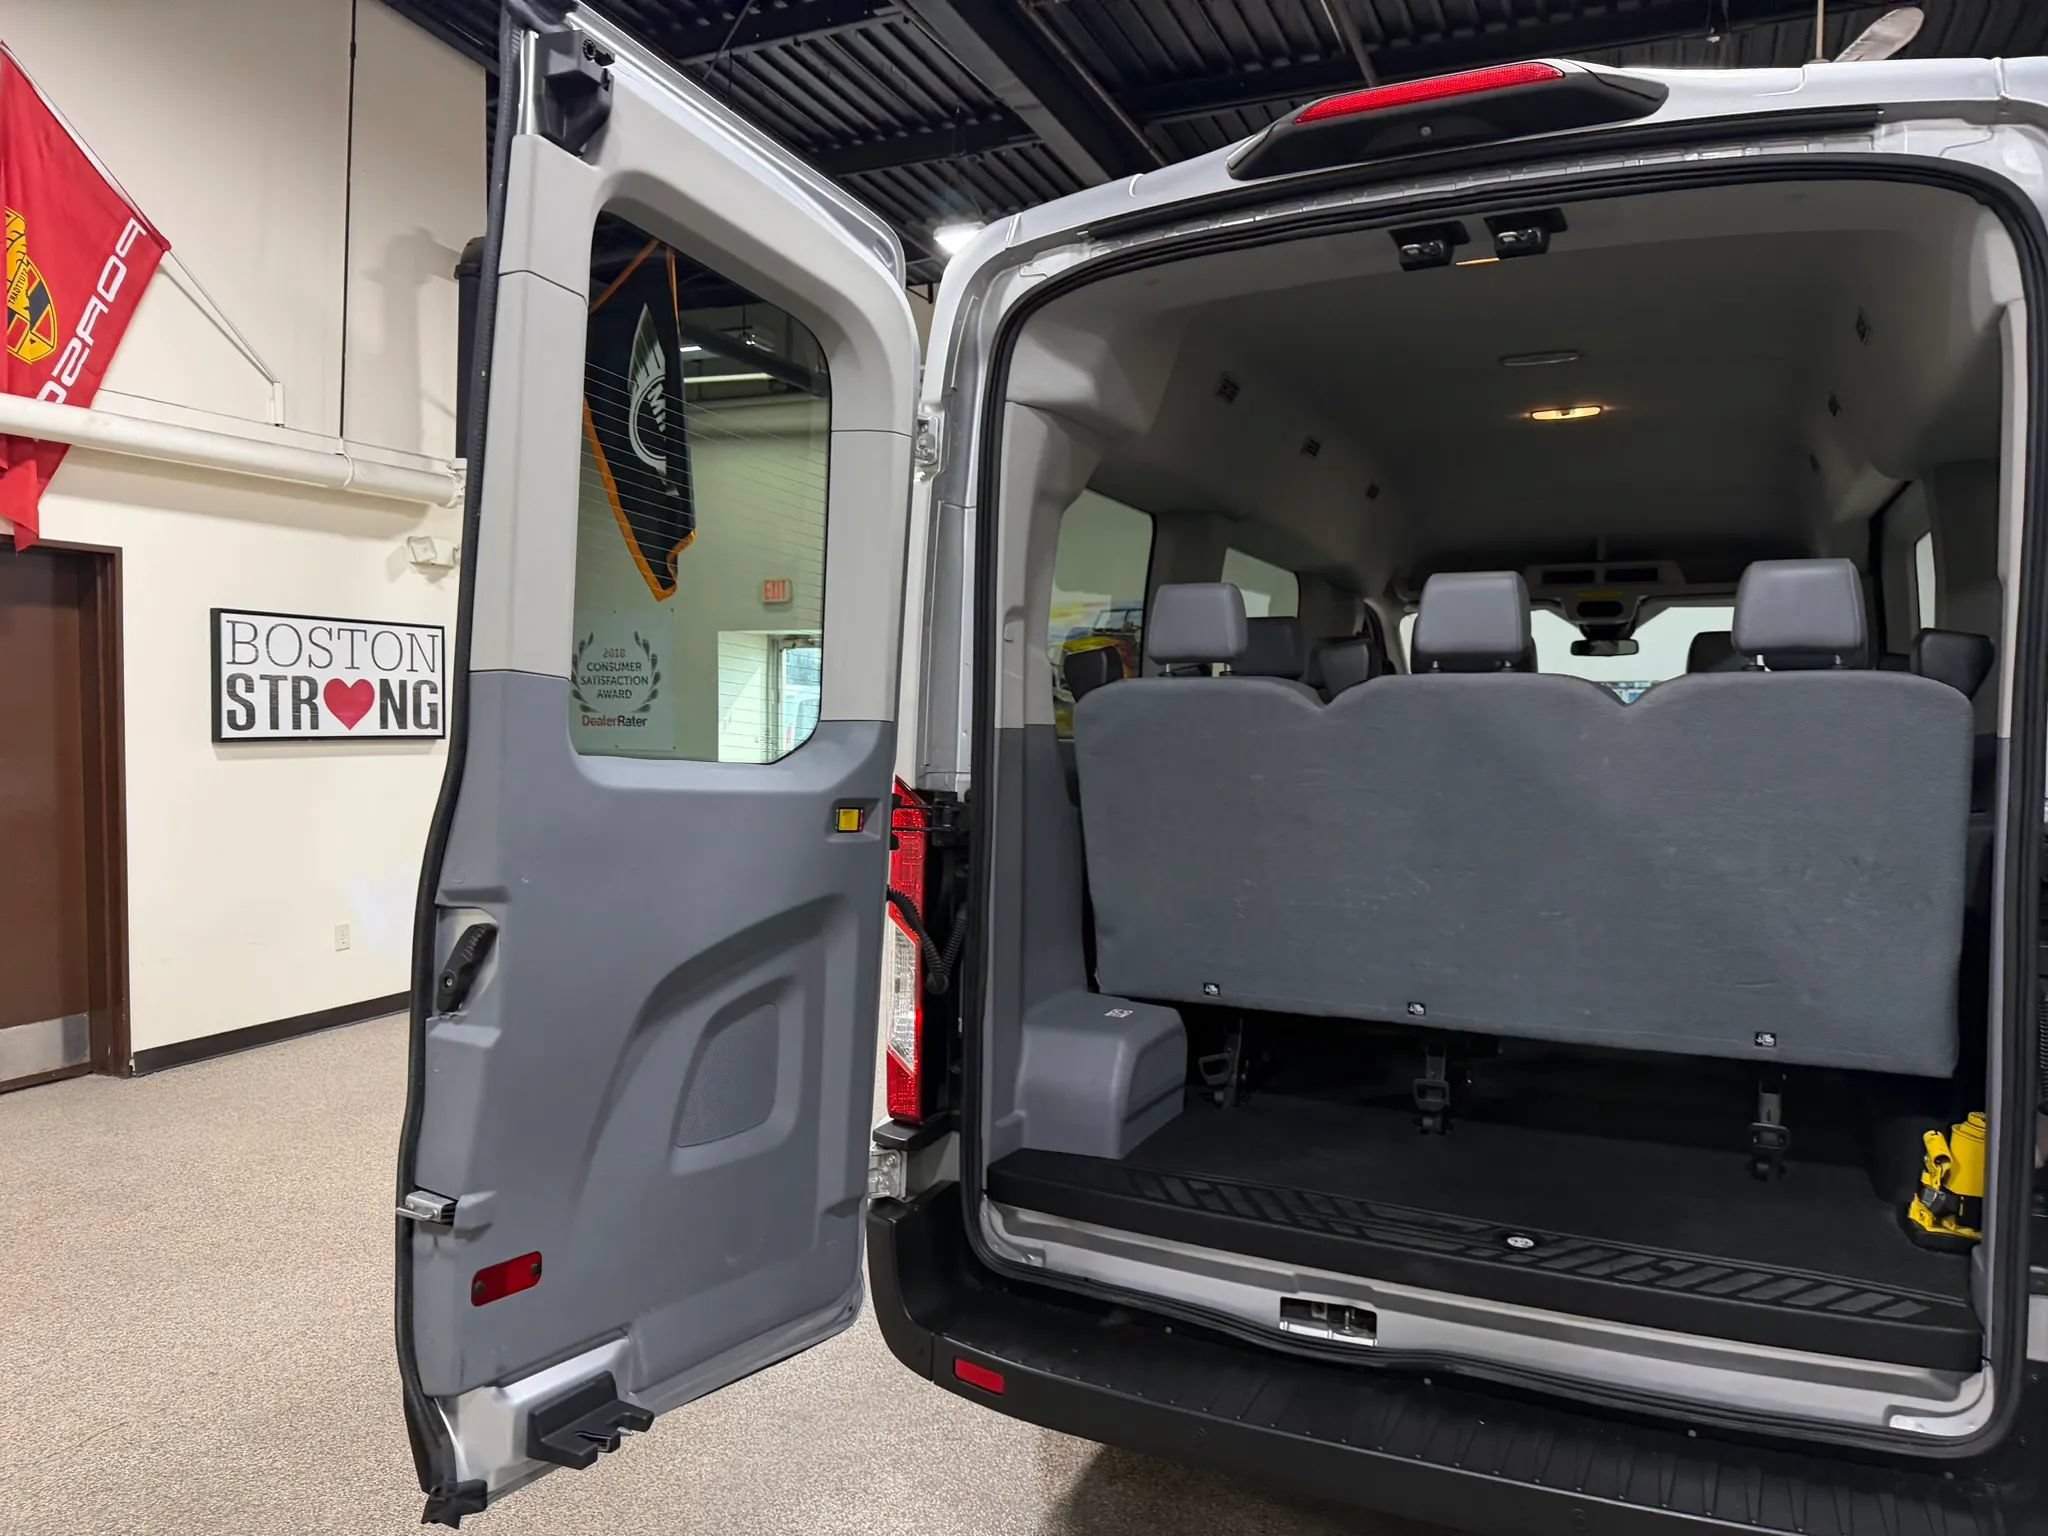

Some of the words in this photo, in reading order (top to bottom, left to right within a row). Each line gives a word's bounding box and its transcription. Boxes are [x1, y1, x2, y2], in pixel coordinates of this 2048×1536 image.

[226, 620, 439, 673] BOSTON
[586, 662, 642, 672] CONSUMER
[580, 675, 649, 686] SATISFACTION
[597, 689, 633, 699] AWARD
[581, 714, 648, 727] DealerRater
